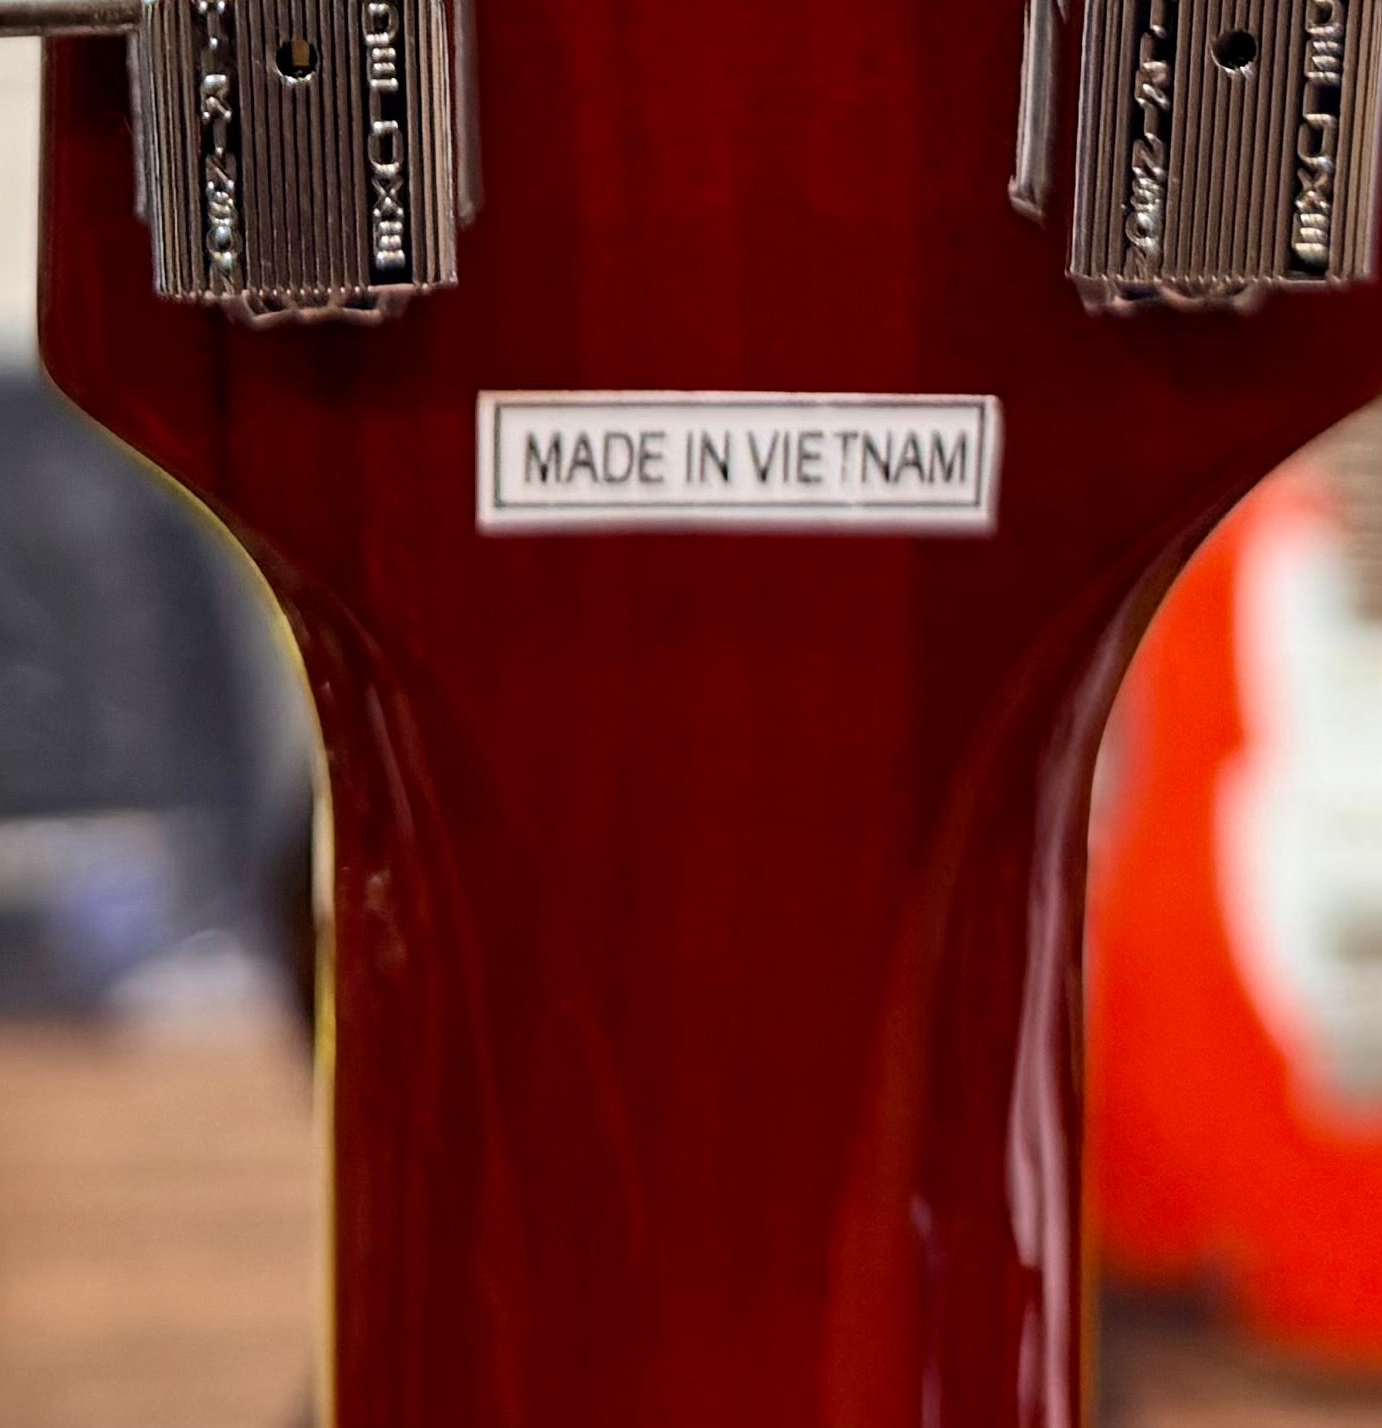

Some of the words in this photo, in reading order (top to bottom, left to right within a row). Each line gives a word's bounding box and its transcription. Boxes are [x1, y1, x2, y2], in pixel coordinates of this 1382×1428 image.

[526, 433, 663, 483] MADE
[687, 435, 729, 482] IN
[750, 433, 966, 484] VIETNAM
